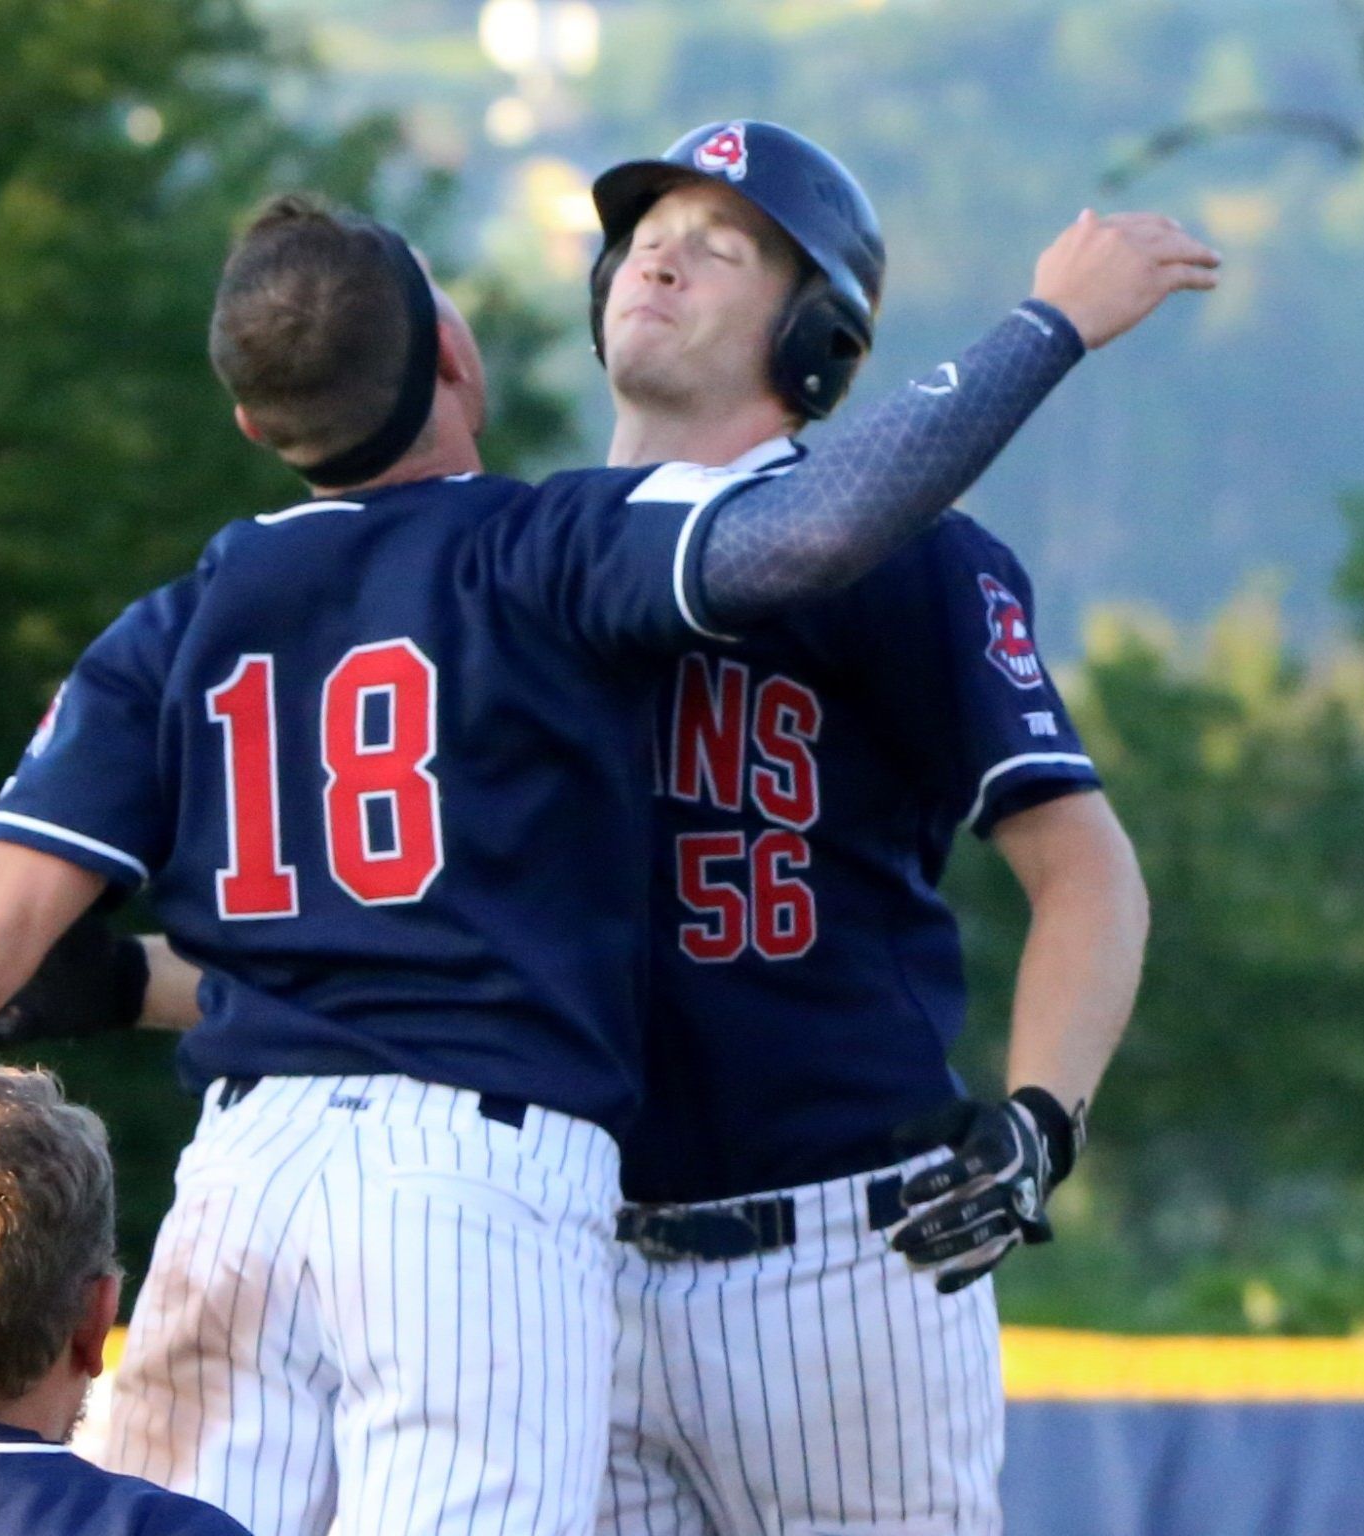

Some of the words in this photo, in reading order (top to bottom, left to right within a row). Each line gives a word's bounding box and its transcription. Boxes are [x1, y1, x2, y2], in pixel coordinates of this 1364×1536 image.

[206, 637, 443, 920] 18
[652, 650, 823, 832] NS
[676, 829, 817, 964] 56
